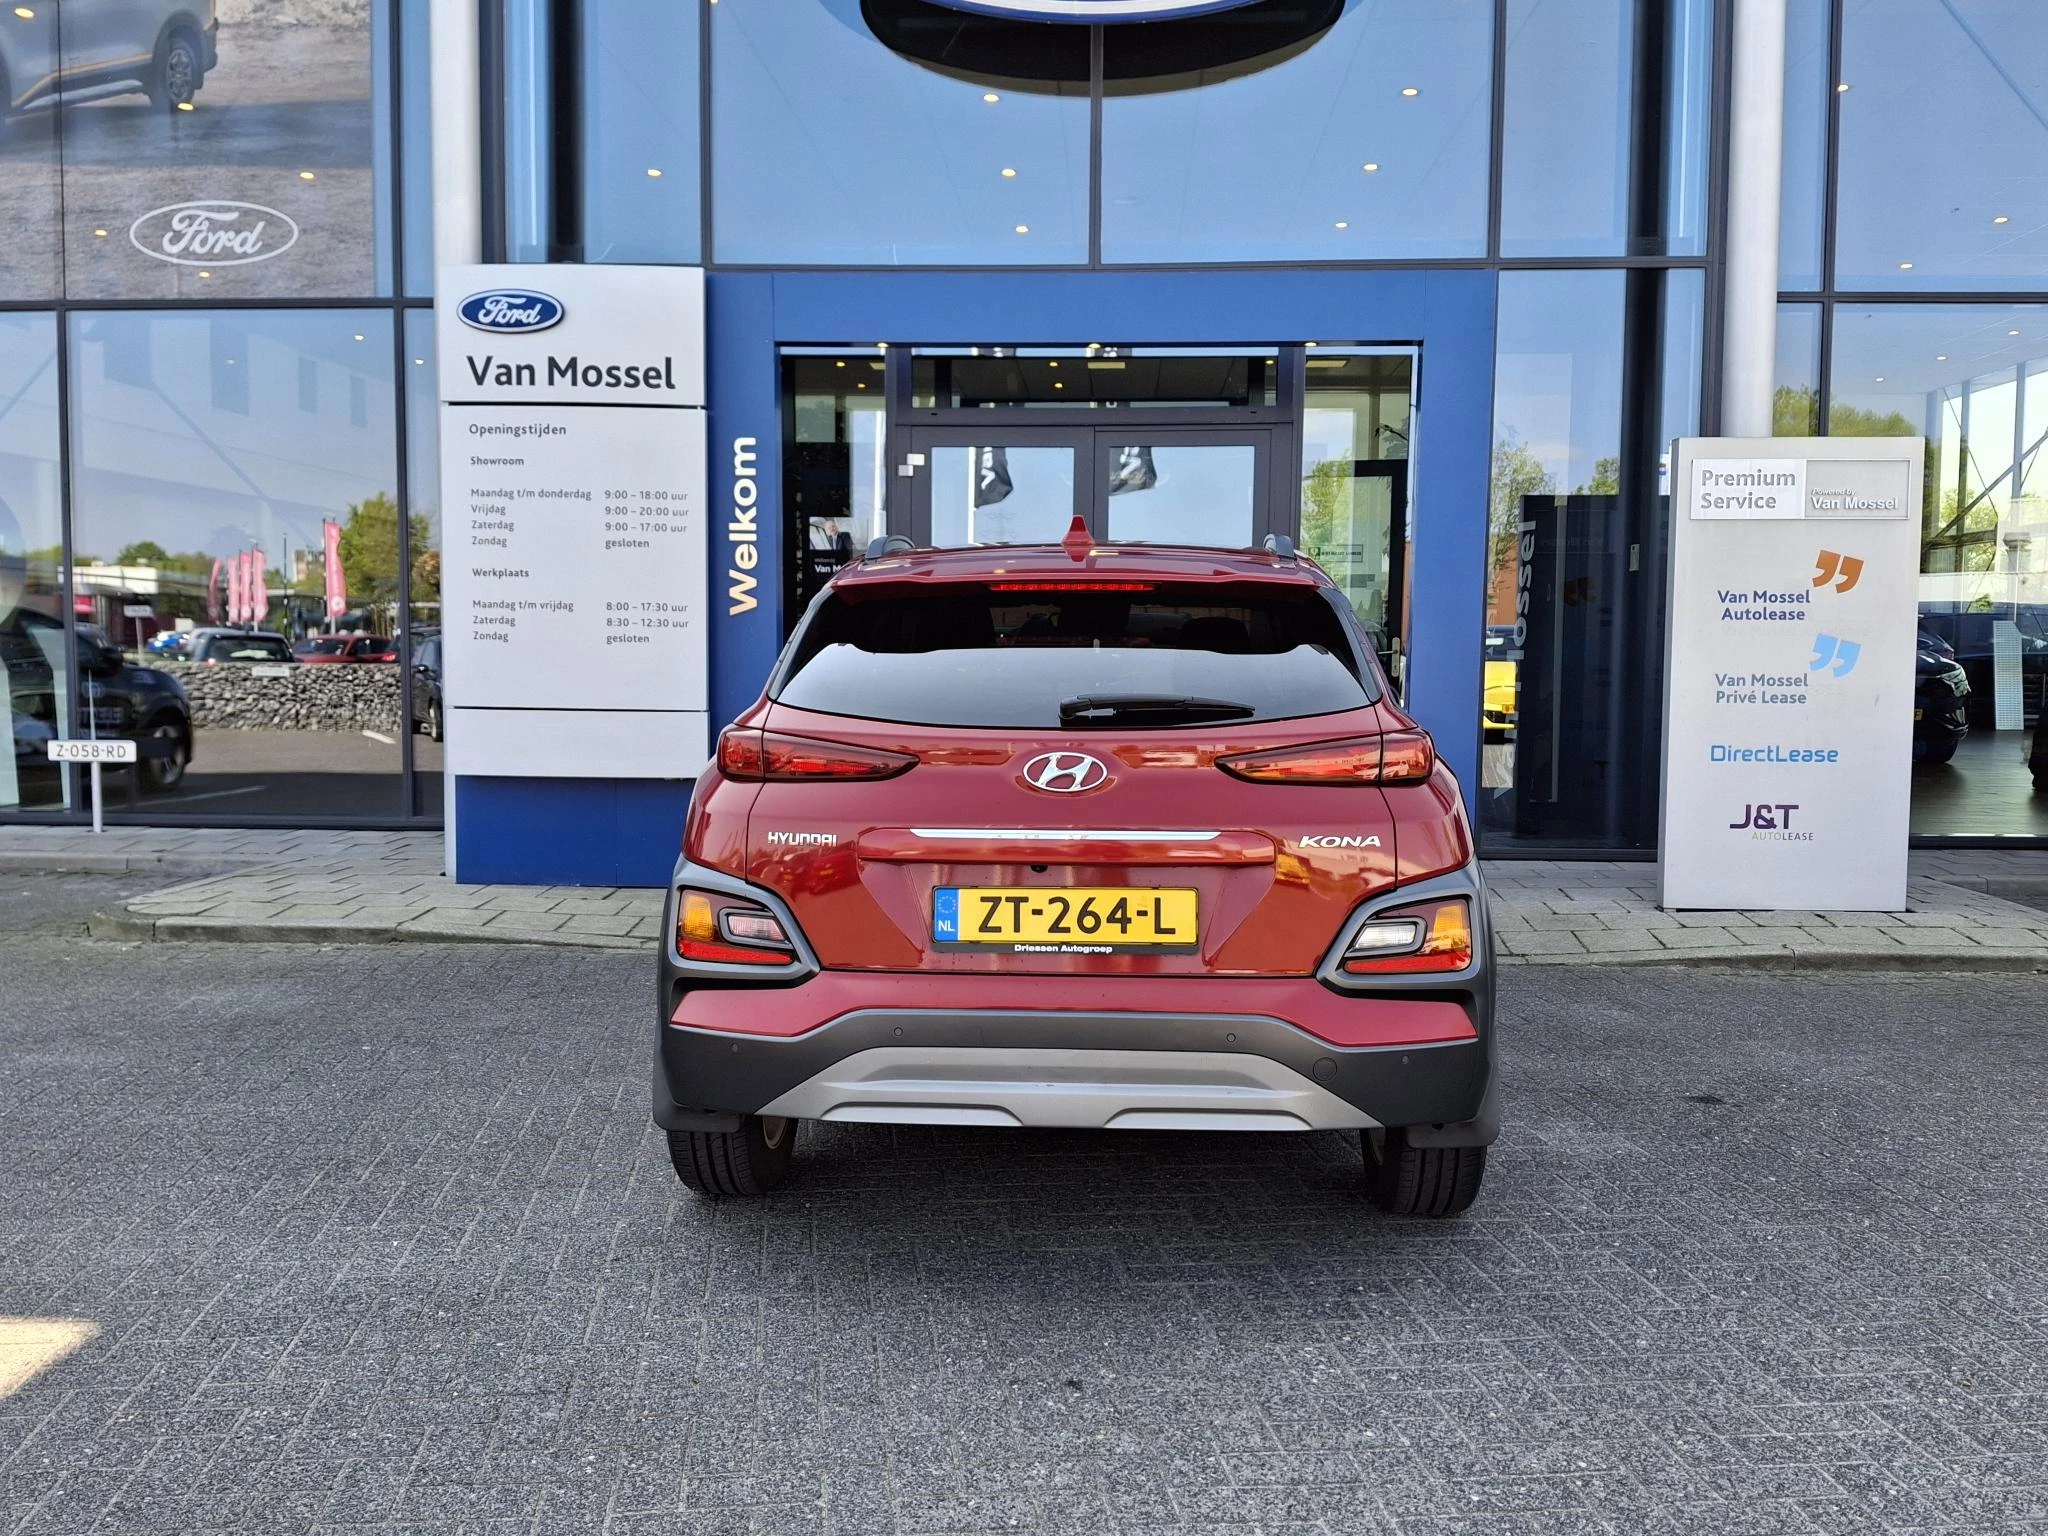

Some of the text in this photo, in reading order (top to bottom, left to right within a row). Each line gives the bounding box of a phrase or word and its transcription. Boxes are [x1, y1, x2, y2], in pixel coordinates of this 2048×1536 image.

[162, 208, 266, 255] Ford
[477, 295, 543, 325] Ford
[466, 354, 677, 390] Van Mossel
[468, 422, 567, 438] Openingstijden
[470, 455, 525, 467] Showroom
[1701, 468, 1796, 487] Premium
[470, 487, 592, 502] Maandag t/m donderdag
[604, 490, 629, 500] 9:00
[639, 490, 668, 501] 18:00
[671, 492, 689, 502] uur
[1811, 487, 1856, 497] Powered by
[1699, 491, 1778, 510] Service
[1811, 496, 1898, 510] Van Mossel
[471, 503, 507, 516] Vrijdag
[604, 506, 629, 516] 9:00
[639, 506, 670, 517] 20:00
[671, 508, 689, 517] uur
[471, 519, 515, 533] Zaterdag
[604, 522, 629, 532] 9:00
[639, 522, 668, 533] 17:00
[671, 524, 688, 534] uur
[728, 436, 759, 617] Welkom
[471, 535, 508, 548] Zondag
[605, 537, 651, 550] gesloten
[472, 567, 530, 580] Werkplaats
[814, 563, 831, 573] Van
[1717, 589, 1811, 604] Van Mossel
[472, 599, 574, 613] Maandag t/m vrijdag
[605, 601, 630, 612] 8:00
[640, 602, 669, 612] 17:30
[671, 603, 689, 613] uur
[1720, 606, 1806, 621] Autolease
[472, 615, 516, 628] Zaterdag
[606, 617, 630, 628] 8:30
[640, 617, 670, 629] 12:30
[671, 619, 689, 629] uur
[472, 631, 509, 643] Zondag
[606, 633, 651, 645] gesloten
[1714, 672, 1809, 688] Van Mossel
[1715, 690, 1807, 705] Privé Lease
[56, 744, 127, 759] Z-058-RD
[1710, 744, 1840, 763] DirectLease
[1729, 803, 1800, 830] J&T
[767, 831, 837, 847] HYUNDAI
[1298, 835, 1381, 848] KONA
[1752, 831, 1814, 841] AUTOLEASE
[978, 895, 1177, 935] ZT-264-L
[937, 919, 955, 932] NL
[1014, 944, 1113, 955] Driessen Autogroep
